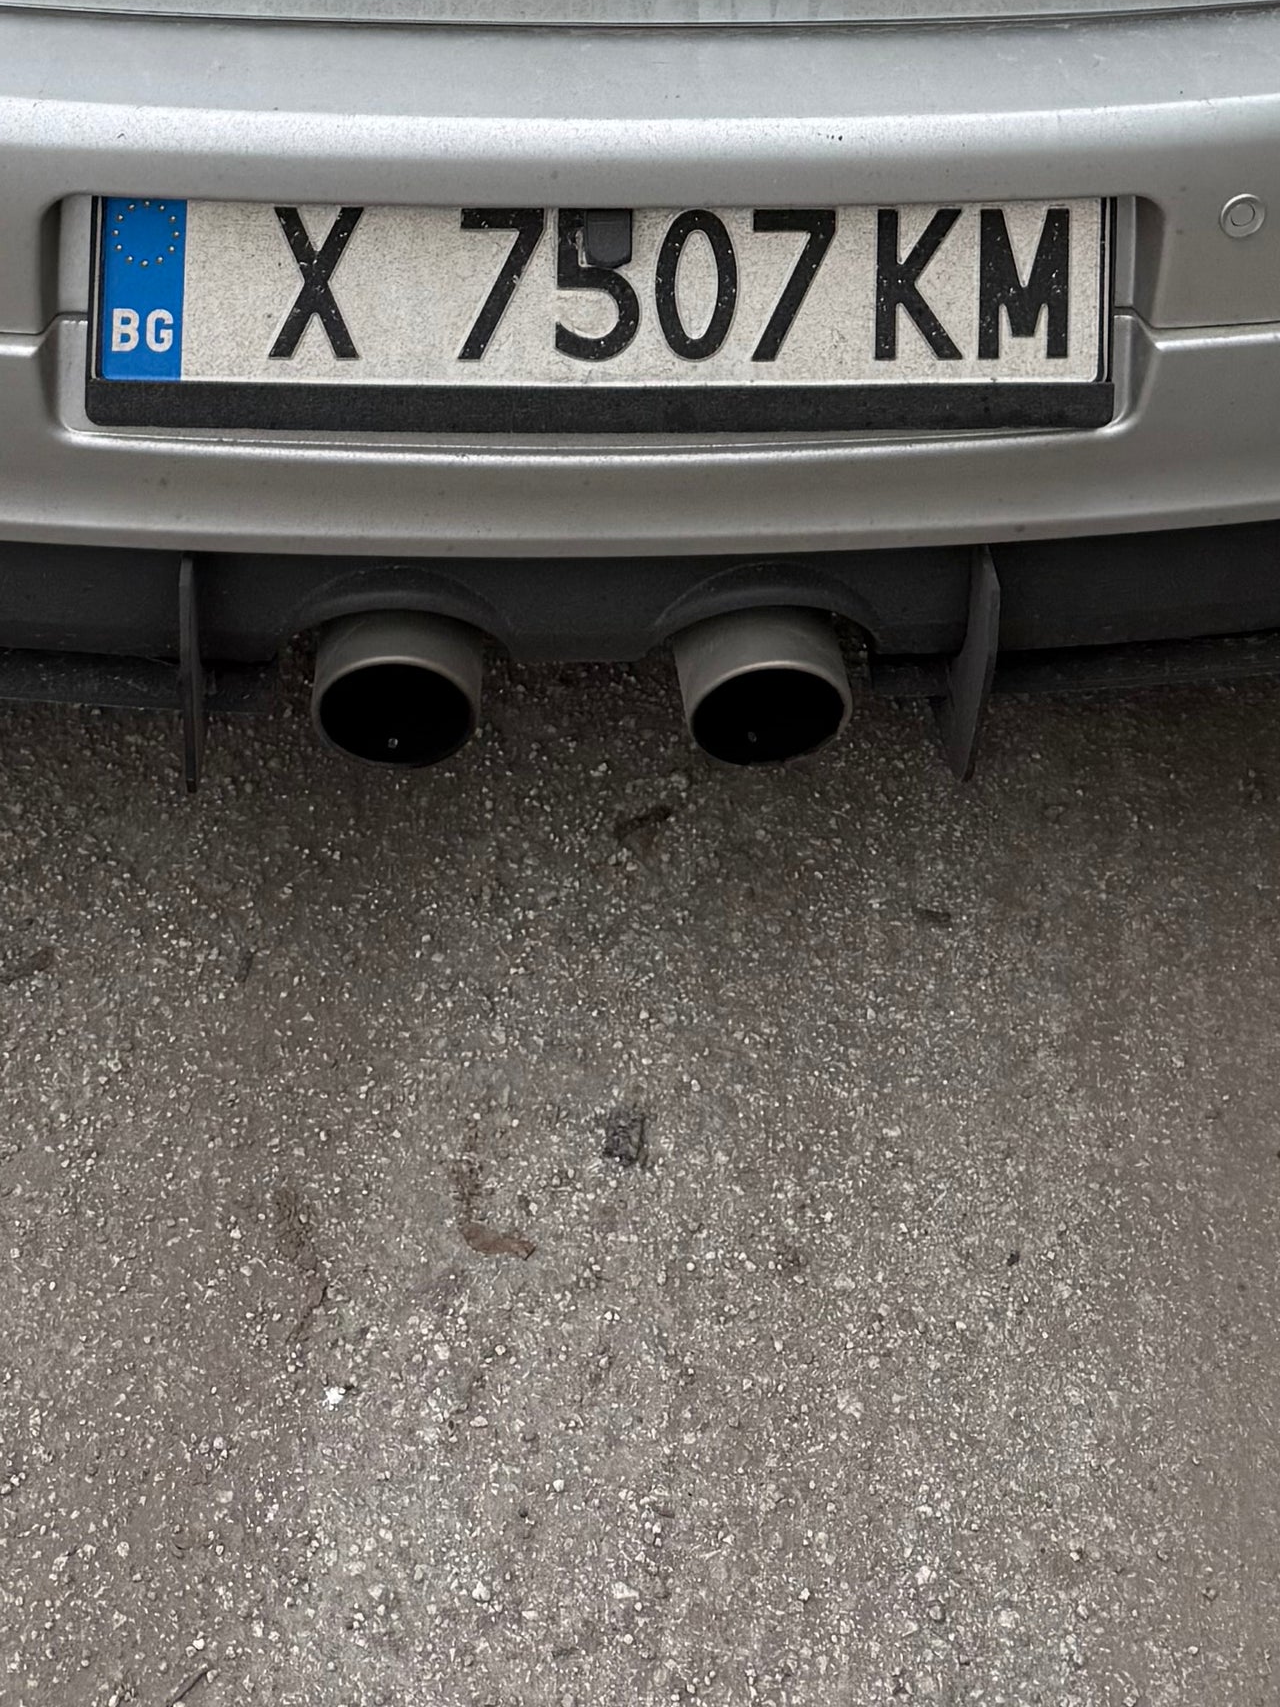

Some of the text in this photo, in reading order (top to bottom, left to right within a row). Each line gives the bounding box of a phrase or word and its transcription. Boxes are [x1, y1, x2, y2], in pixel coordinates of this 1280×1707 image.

[111, 308, 175, 353] BG
[269, 206, 1070, 362] X 7507 KM
